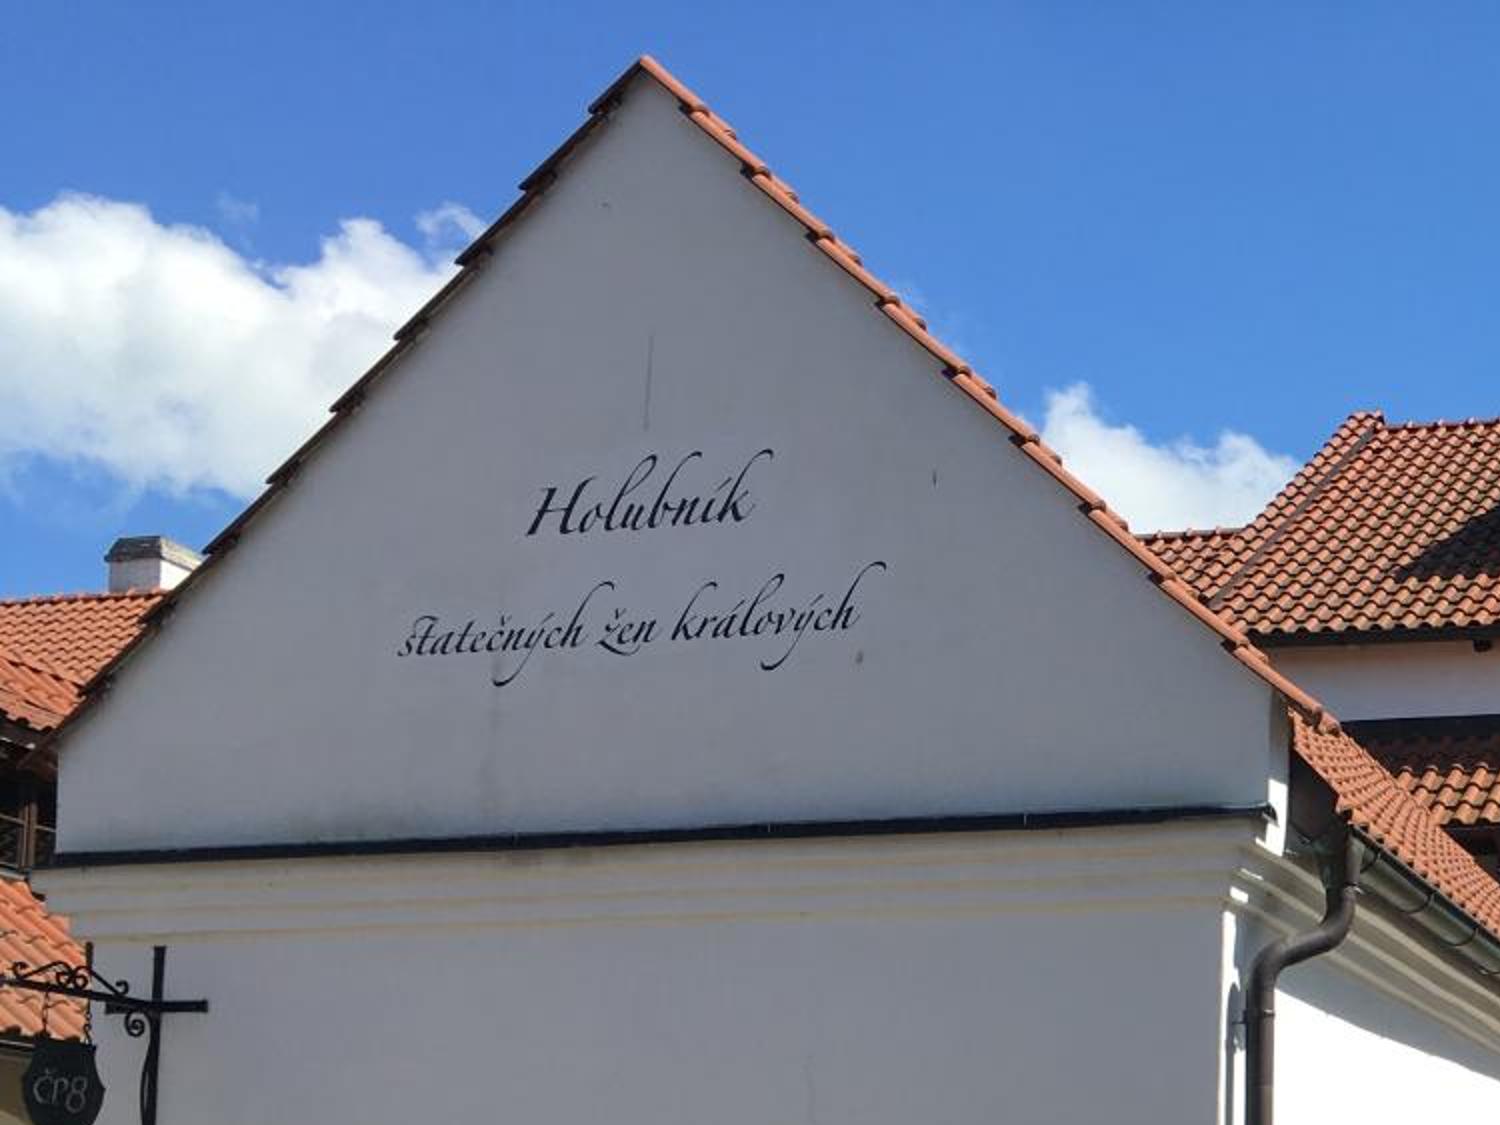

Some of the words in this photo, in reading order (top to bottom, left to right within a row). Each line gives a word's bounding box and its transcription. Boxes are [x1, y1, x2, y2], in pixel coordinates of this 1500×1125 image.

[526, 448, 774, 537] Holubník
[597, 608, 661, 656] žen
[671, 561, 887, 670] králových
